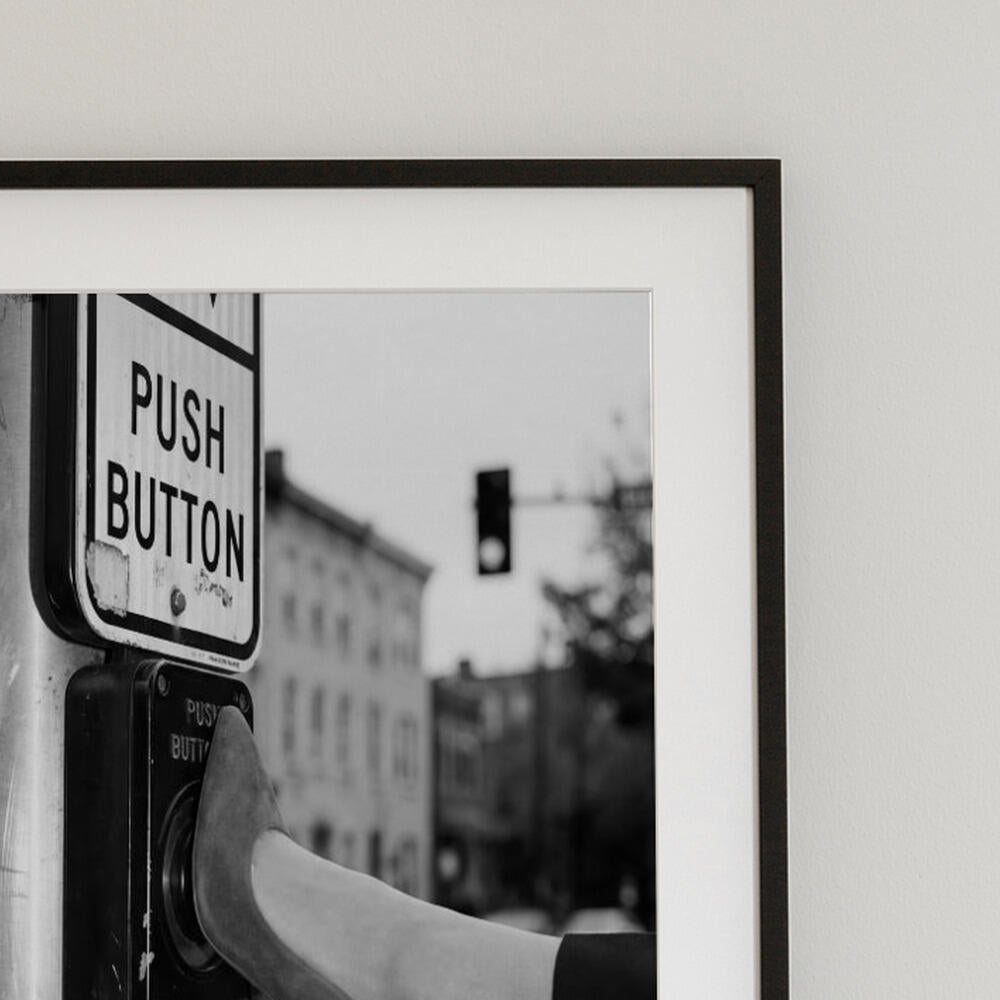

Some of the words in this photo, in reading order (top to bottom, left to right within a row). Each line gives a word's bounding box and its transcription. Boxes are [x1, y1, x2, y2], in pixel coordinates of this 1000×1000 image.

[131, 360, 225, 475] PUSH
[107, 460, 244, 582] BUTTON
[170, 733, 210, 762] BUTT
